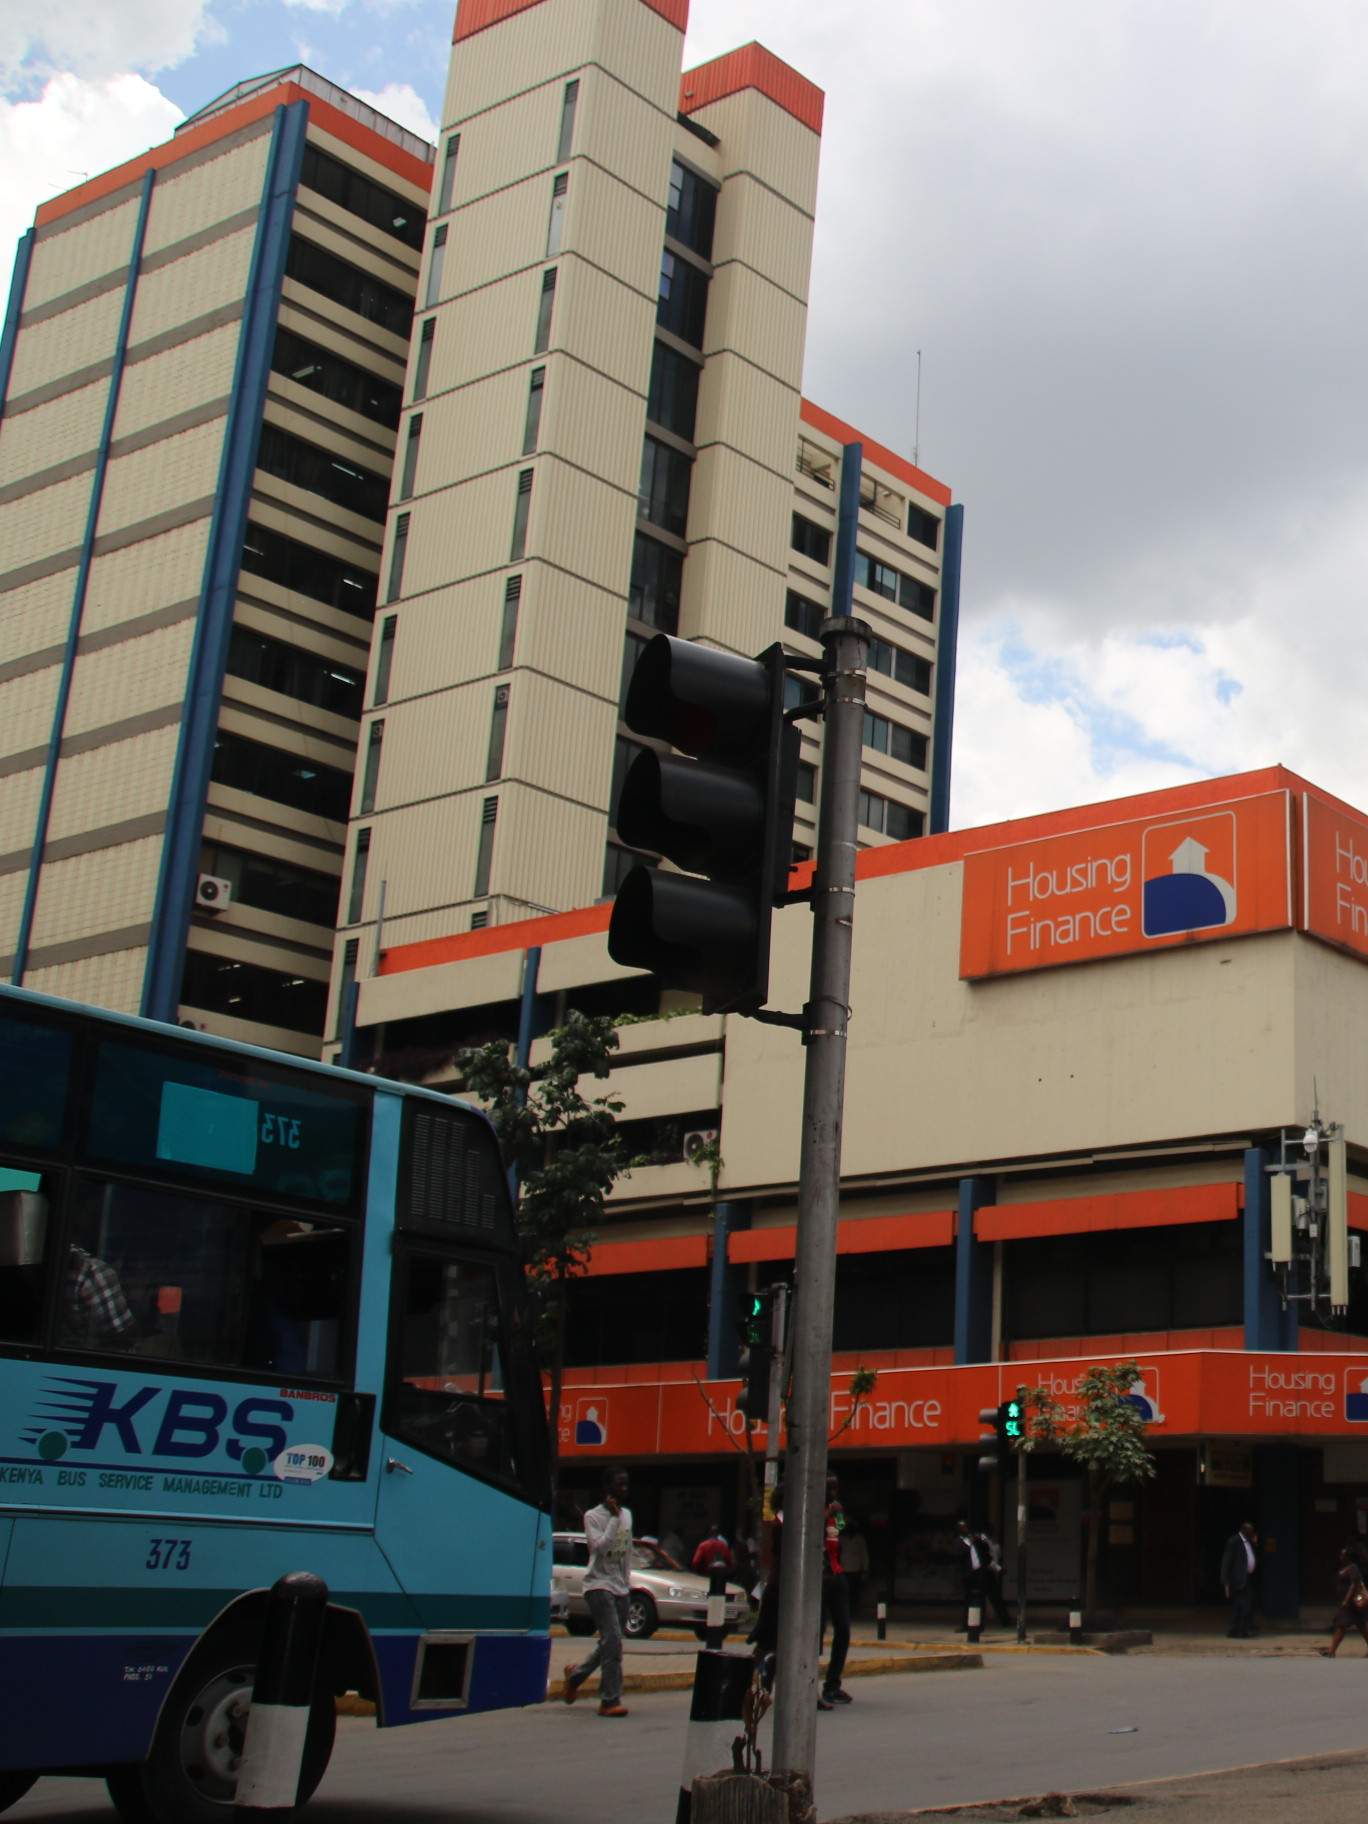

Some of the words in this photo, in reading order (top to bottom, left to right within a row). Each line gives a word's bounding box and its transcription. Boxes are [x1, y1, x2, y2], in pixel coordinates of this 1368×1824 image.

[1007, 852, 1131, 906] Housing
[1007, 904, 1131, 955] Finance
[1249, 1365, 1336, 1396] Housing
[829, 1389, 942, 1431] Finance
[1249, 1392, 1335, 1418] Finance
[68, 1382, 294, 1465] KBS
[287, 1452, 306, 1465] TOP
[307, 1455, 326, 1468] 100
[0, 1466, 44, 1485] KENYA
[57, 1470, 87, 1487] BUS
[99, 1471, 154, 1491] SERVICE
[162, 1477, 252, 1499] MANAGEMENT
[258, 1481, 283, 1499] LTD
[146, 1538, 193, 1570] 373
